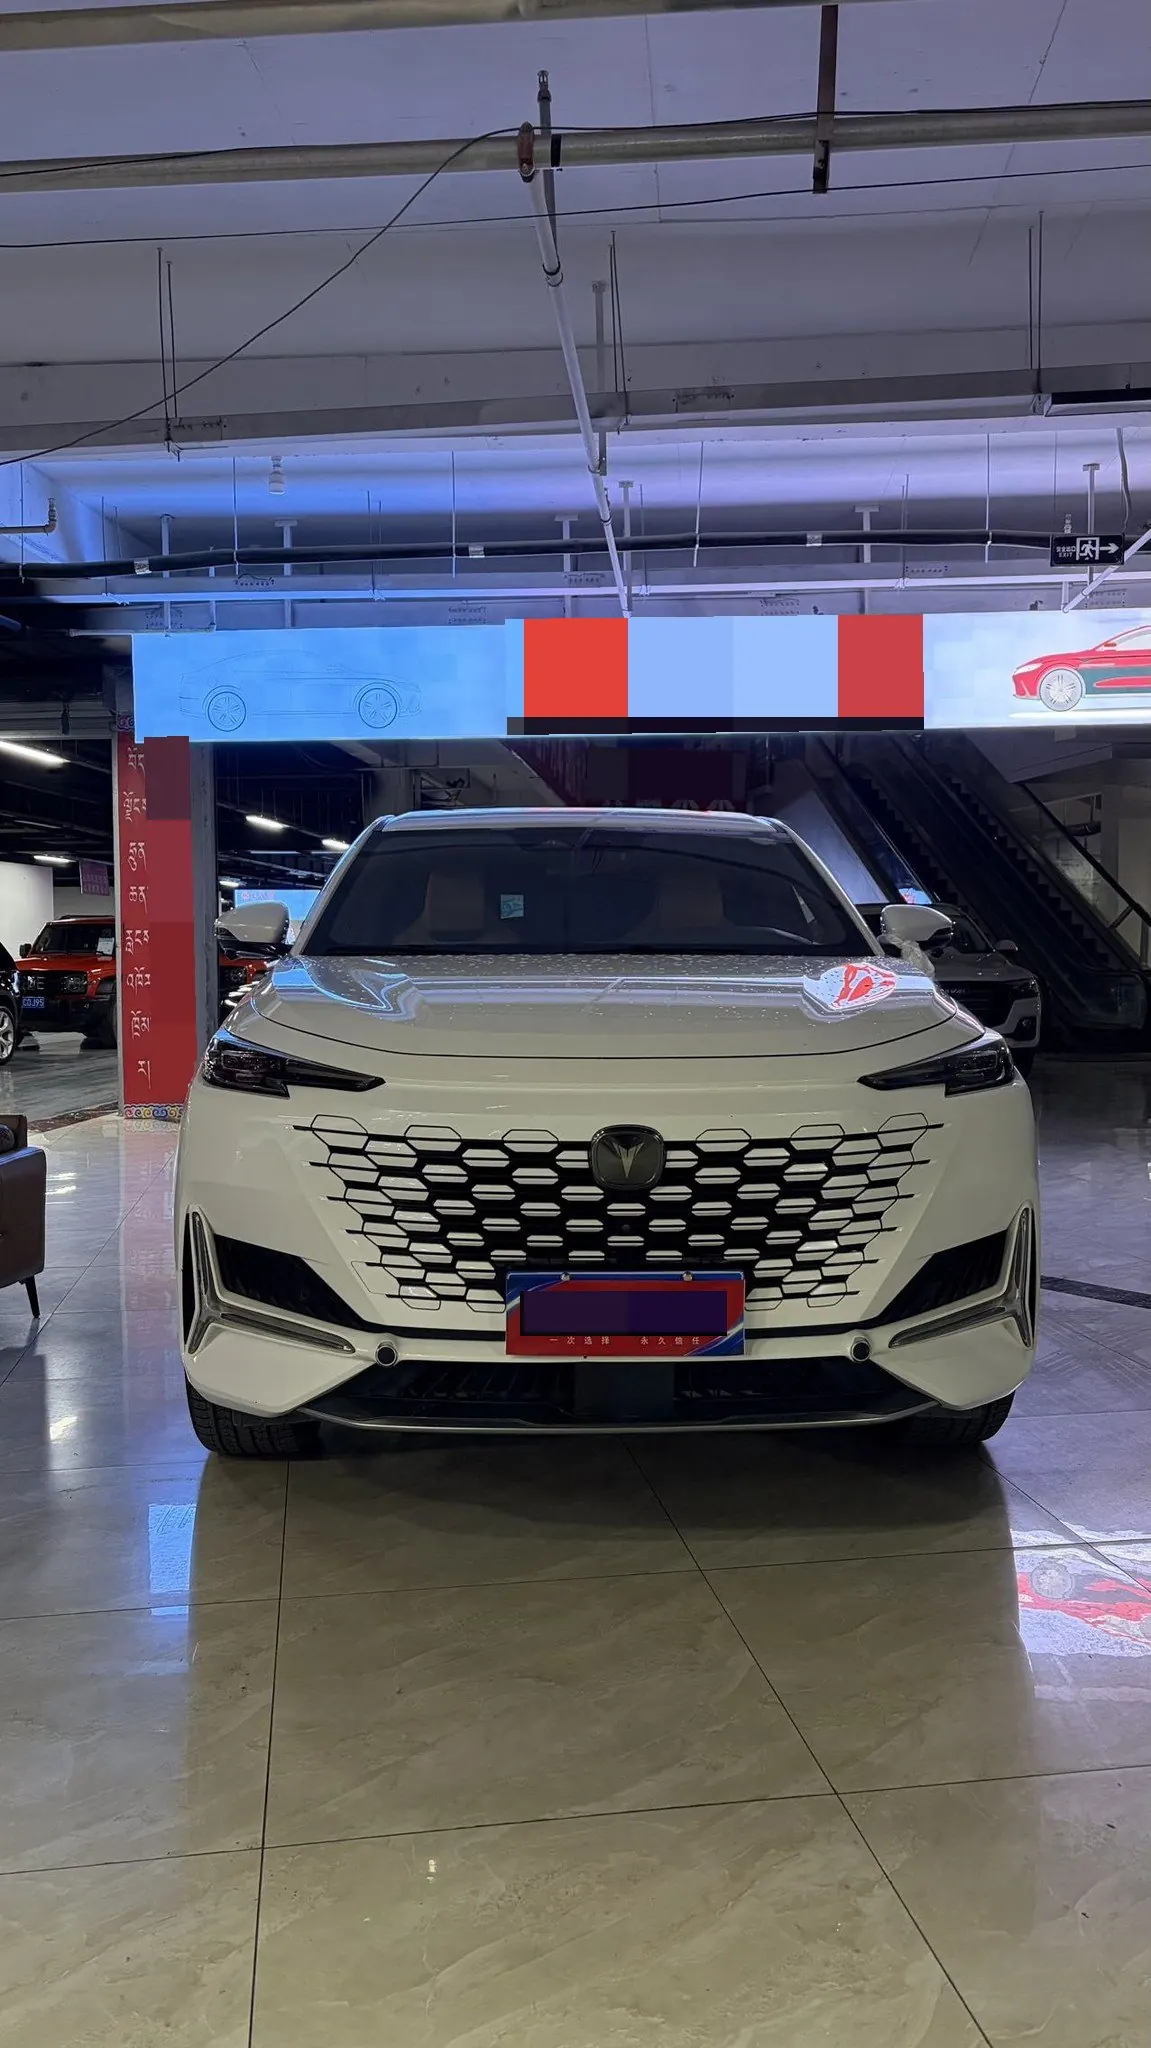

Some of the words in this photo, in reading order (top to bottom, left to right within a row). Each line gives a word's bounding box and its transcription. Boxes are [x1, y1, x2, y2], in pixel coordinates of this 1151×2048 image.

[549, 1336, 611, 1346] 一次选择
[640, 1336, 700, 1346] 永久信任
